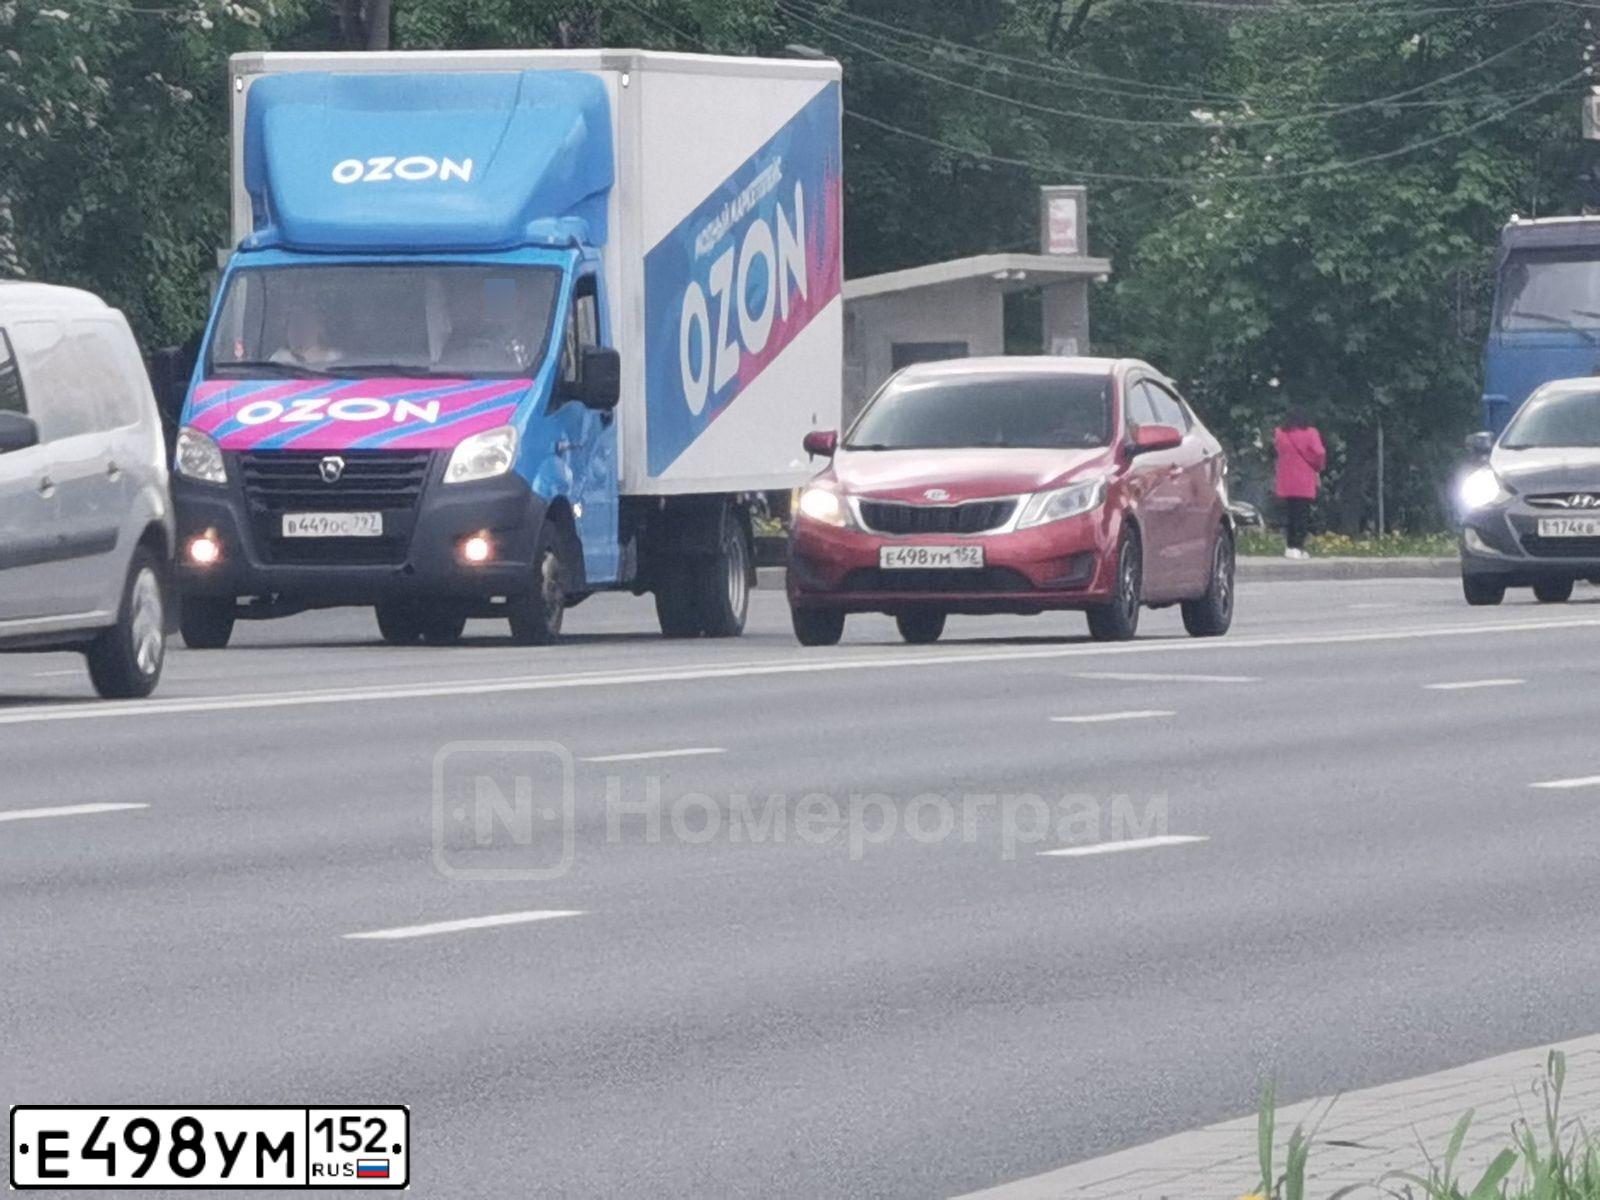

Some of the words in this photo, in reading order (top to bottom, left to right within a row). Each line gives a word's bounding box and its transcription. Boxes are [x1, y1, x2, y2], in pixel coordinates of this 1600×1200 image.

[332, 156, 472, 184] OZON
[680, 180, 807, 416] OZON
[236, 397, 440, 424] OZON
[953, 547, 978, 562] 152
